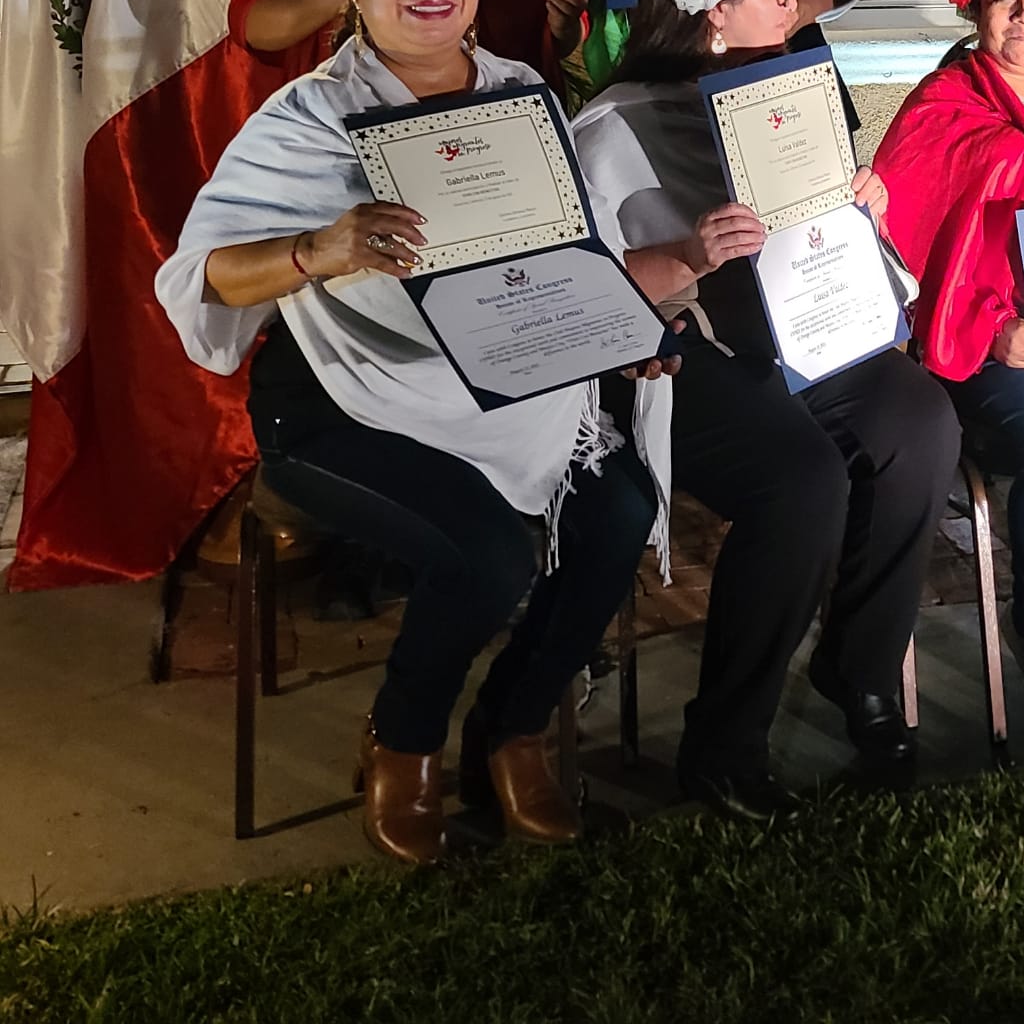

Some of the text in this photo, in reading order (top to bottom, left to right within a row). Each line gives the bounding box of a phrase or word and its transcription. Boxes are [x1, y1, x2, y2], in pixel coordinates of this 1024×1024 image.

[446, 169, 506, 186] Gabriella Lemus
[511, 315, 554, 335] Gabriella
[556, 307, 585, 321] Lemus
